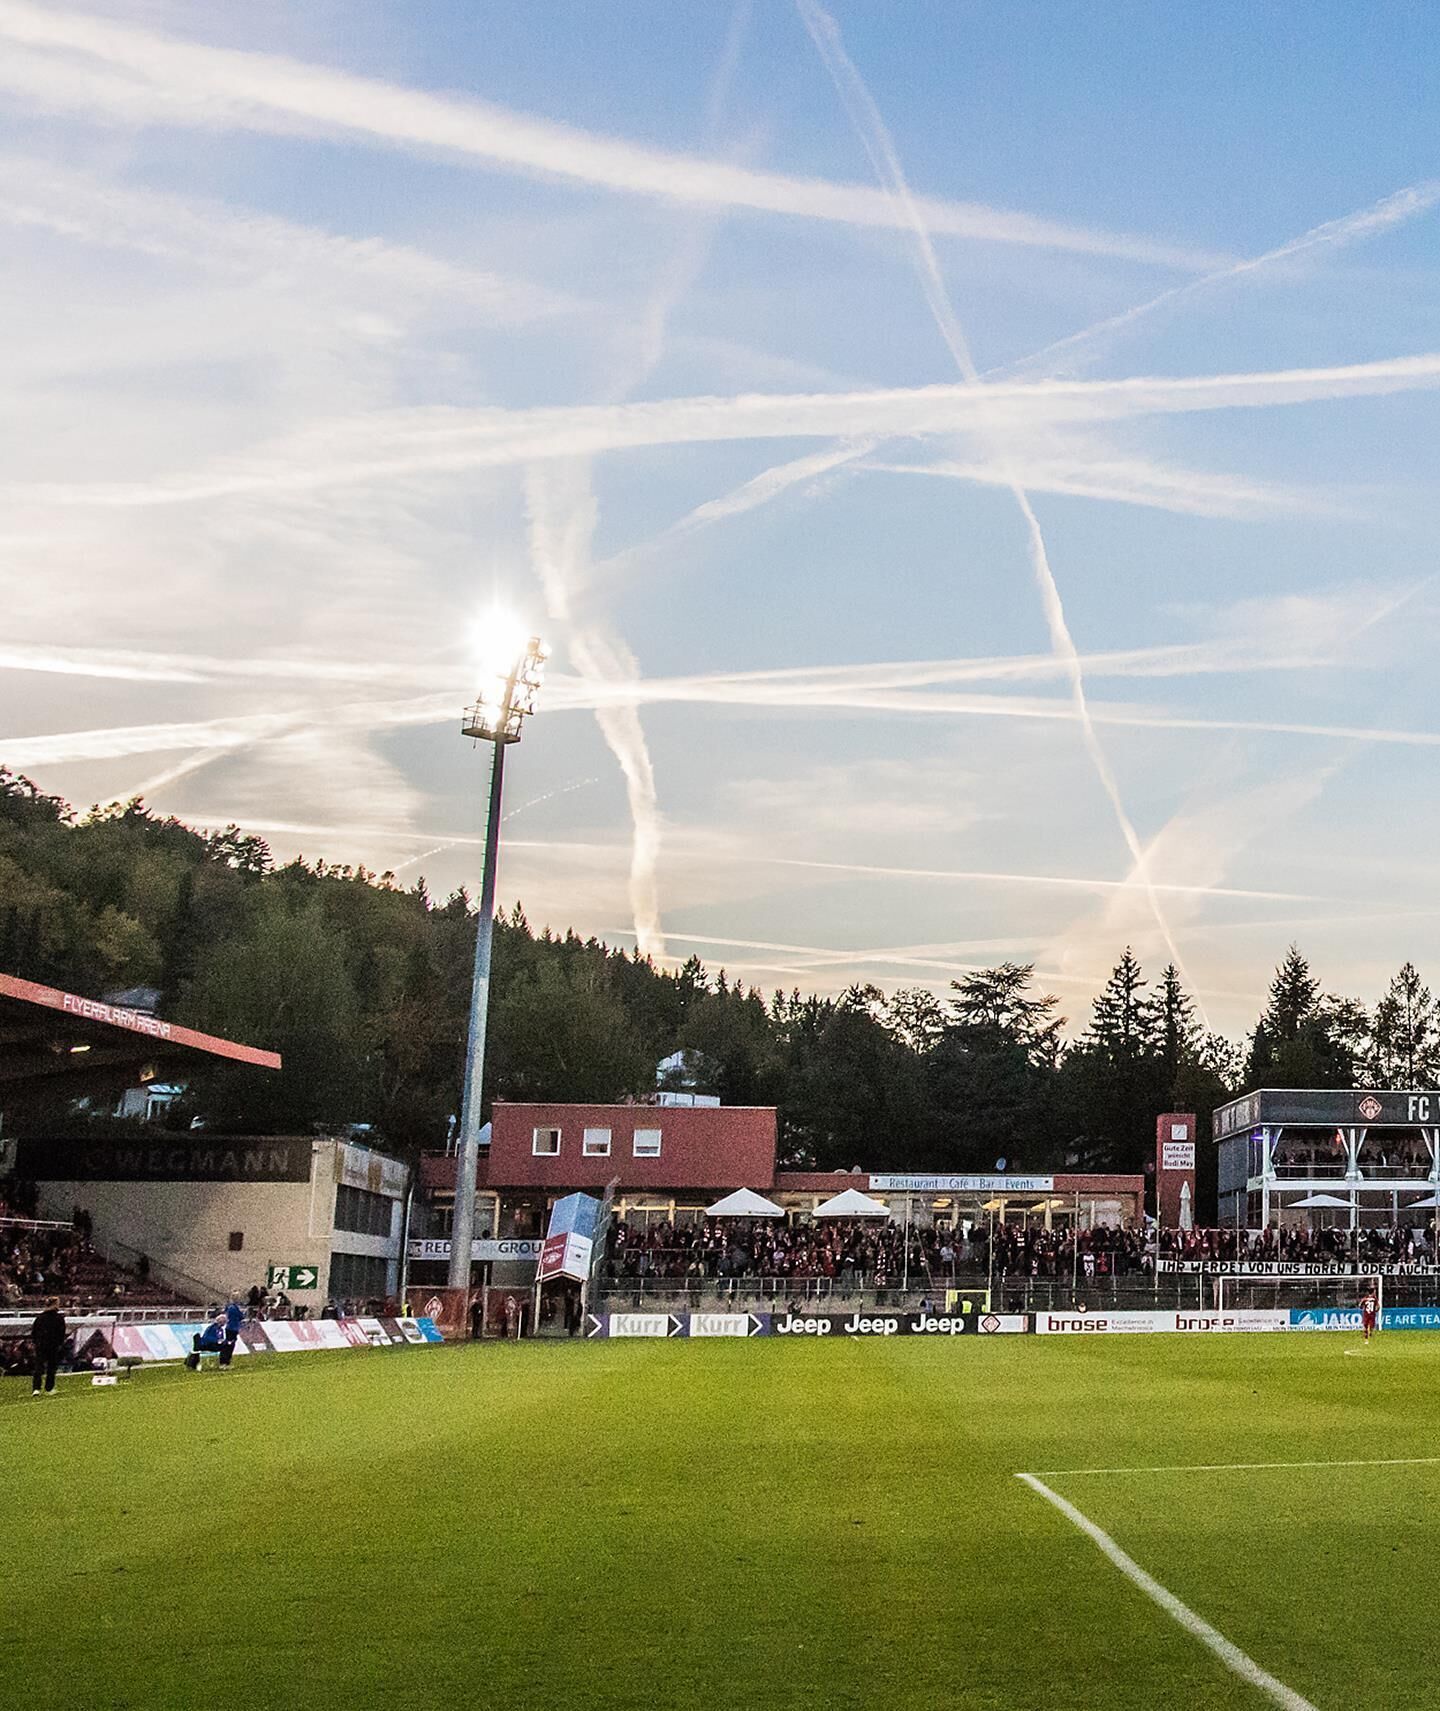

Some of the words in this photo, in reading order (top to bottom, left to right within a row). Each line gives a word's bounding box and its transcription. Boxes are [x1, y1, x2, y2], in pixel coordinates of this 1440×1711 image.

[63, 994, 136, 1026] FLYERALARM
[137, 1014, 171, 1038] ARENA
[1408, 1096, 1430, 1121] FC
[116, 1149, 290, 1173] WEGMANN
[889, 1178, 938, 1189] Restaurant
[949, 1177, 969, 1189] Café
[979, 1178, 994, 1189] Bar
[1005, 1178, 1035, 1189] Events
[498, 1242, 542, 1255] GROU
[1163, 1262, 1185, 1272] IHR
[1190, 1262, 1245, 1273] WERDET
[1249, 1263, 1273, 1273] VON
[1277, 1263, 1300, 1273] UNS
[1362, 1264, 1395, 1275] ODER
[1400, 1264, 1429, 1275] AUCH
[615, 1317, 663, 1335] Kurr
[695, 1317, 743, 1335] Kurr
[777, 1314, 831, 1336] Jeep
[844, 1314, 898, 1336] Jeep
[911, 1313, 965, 1335] Jeep
[1048, 1316, 1108, 1332] brose
[1322, 1311, 1363, 1328] JAKO
[1395, 1314, 1417, 1324] ARE
